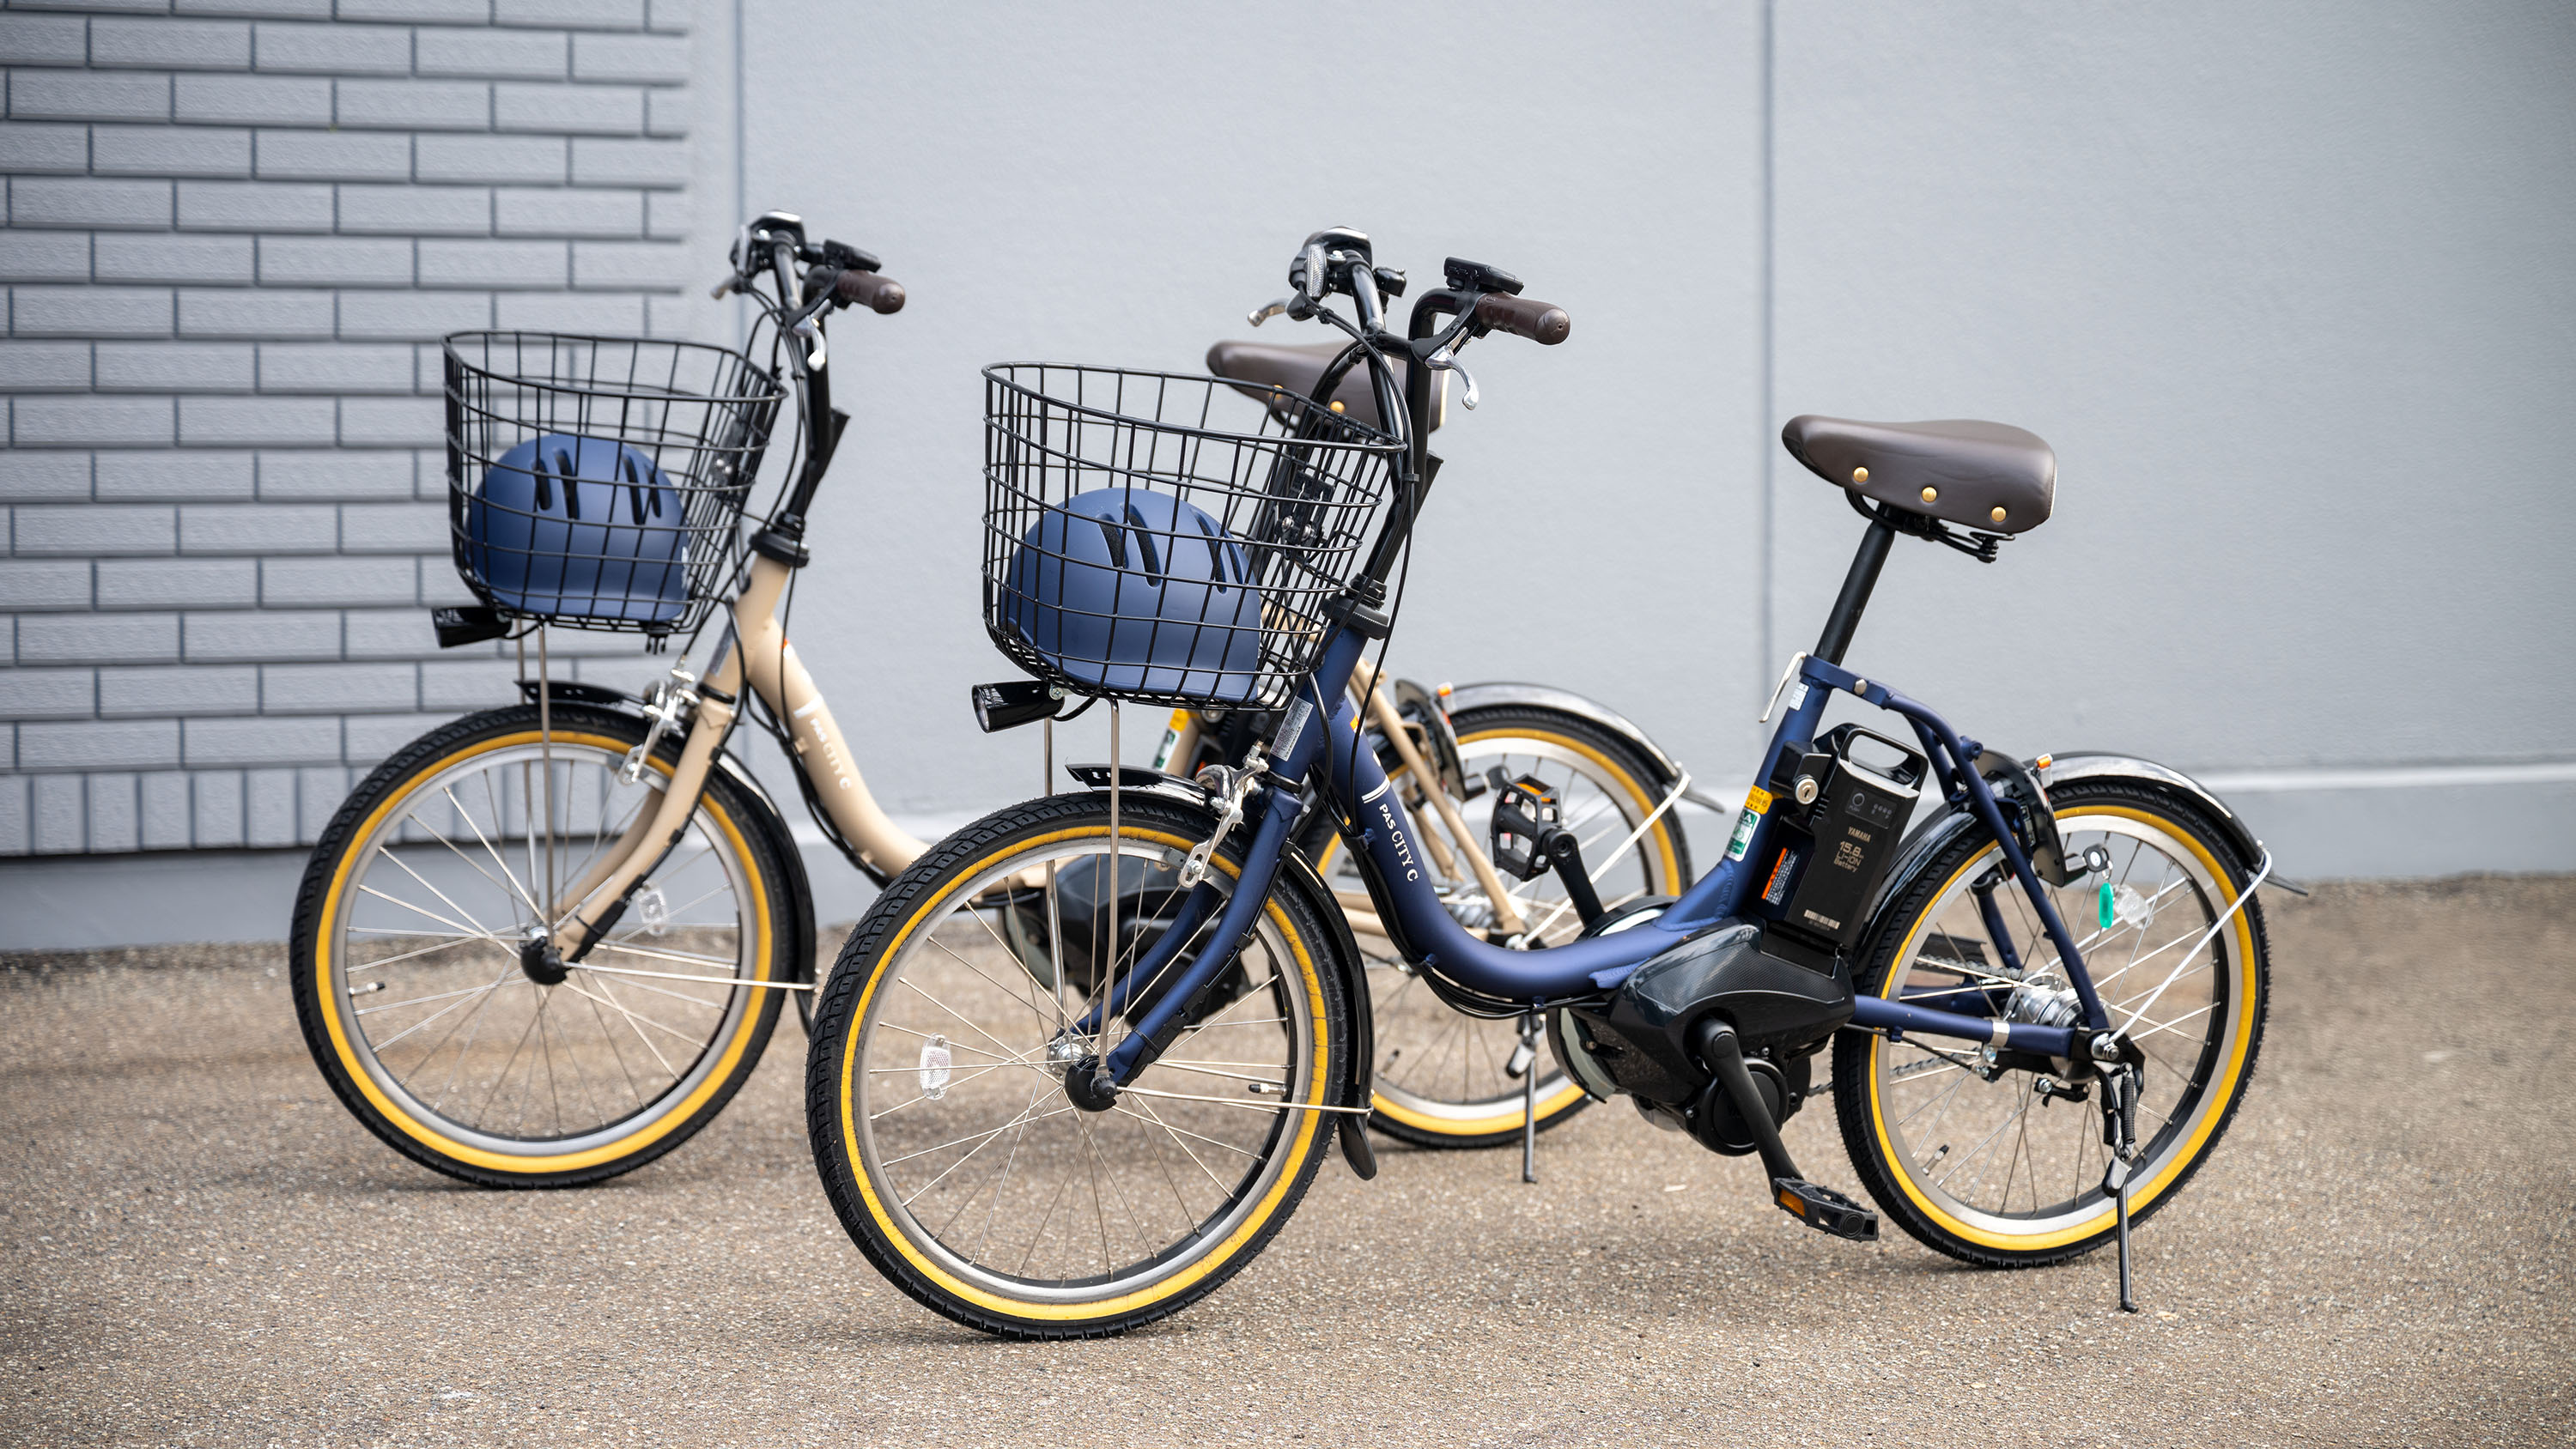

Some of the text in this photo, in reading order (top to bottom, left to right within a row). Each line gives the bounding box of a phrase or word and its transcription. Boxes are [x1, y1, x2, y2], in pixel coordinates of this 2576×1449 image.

[839, 777, 852, 790] C
[1848, 827, 1871, 843] YAMAHA
[1380, 804, 1419, 882] PAS CITY C
[1834, 857, 1857, 872] Battery
